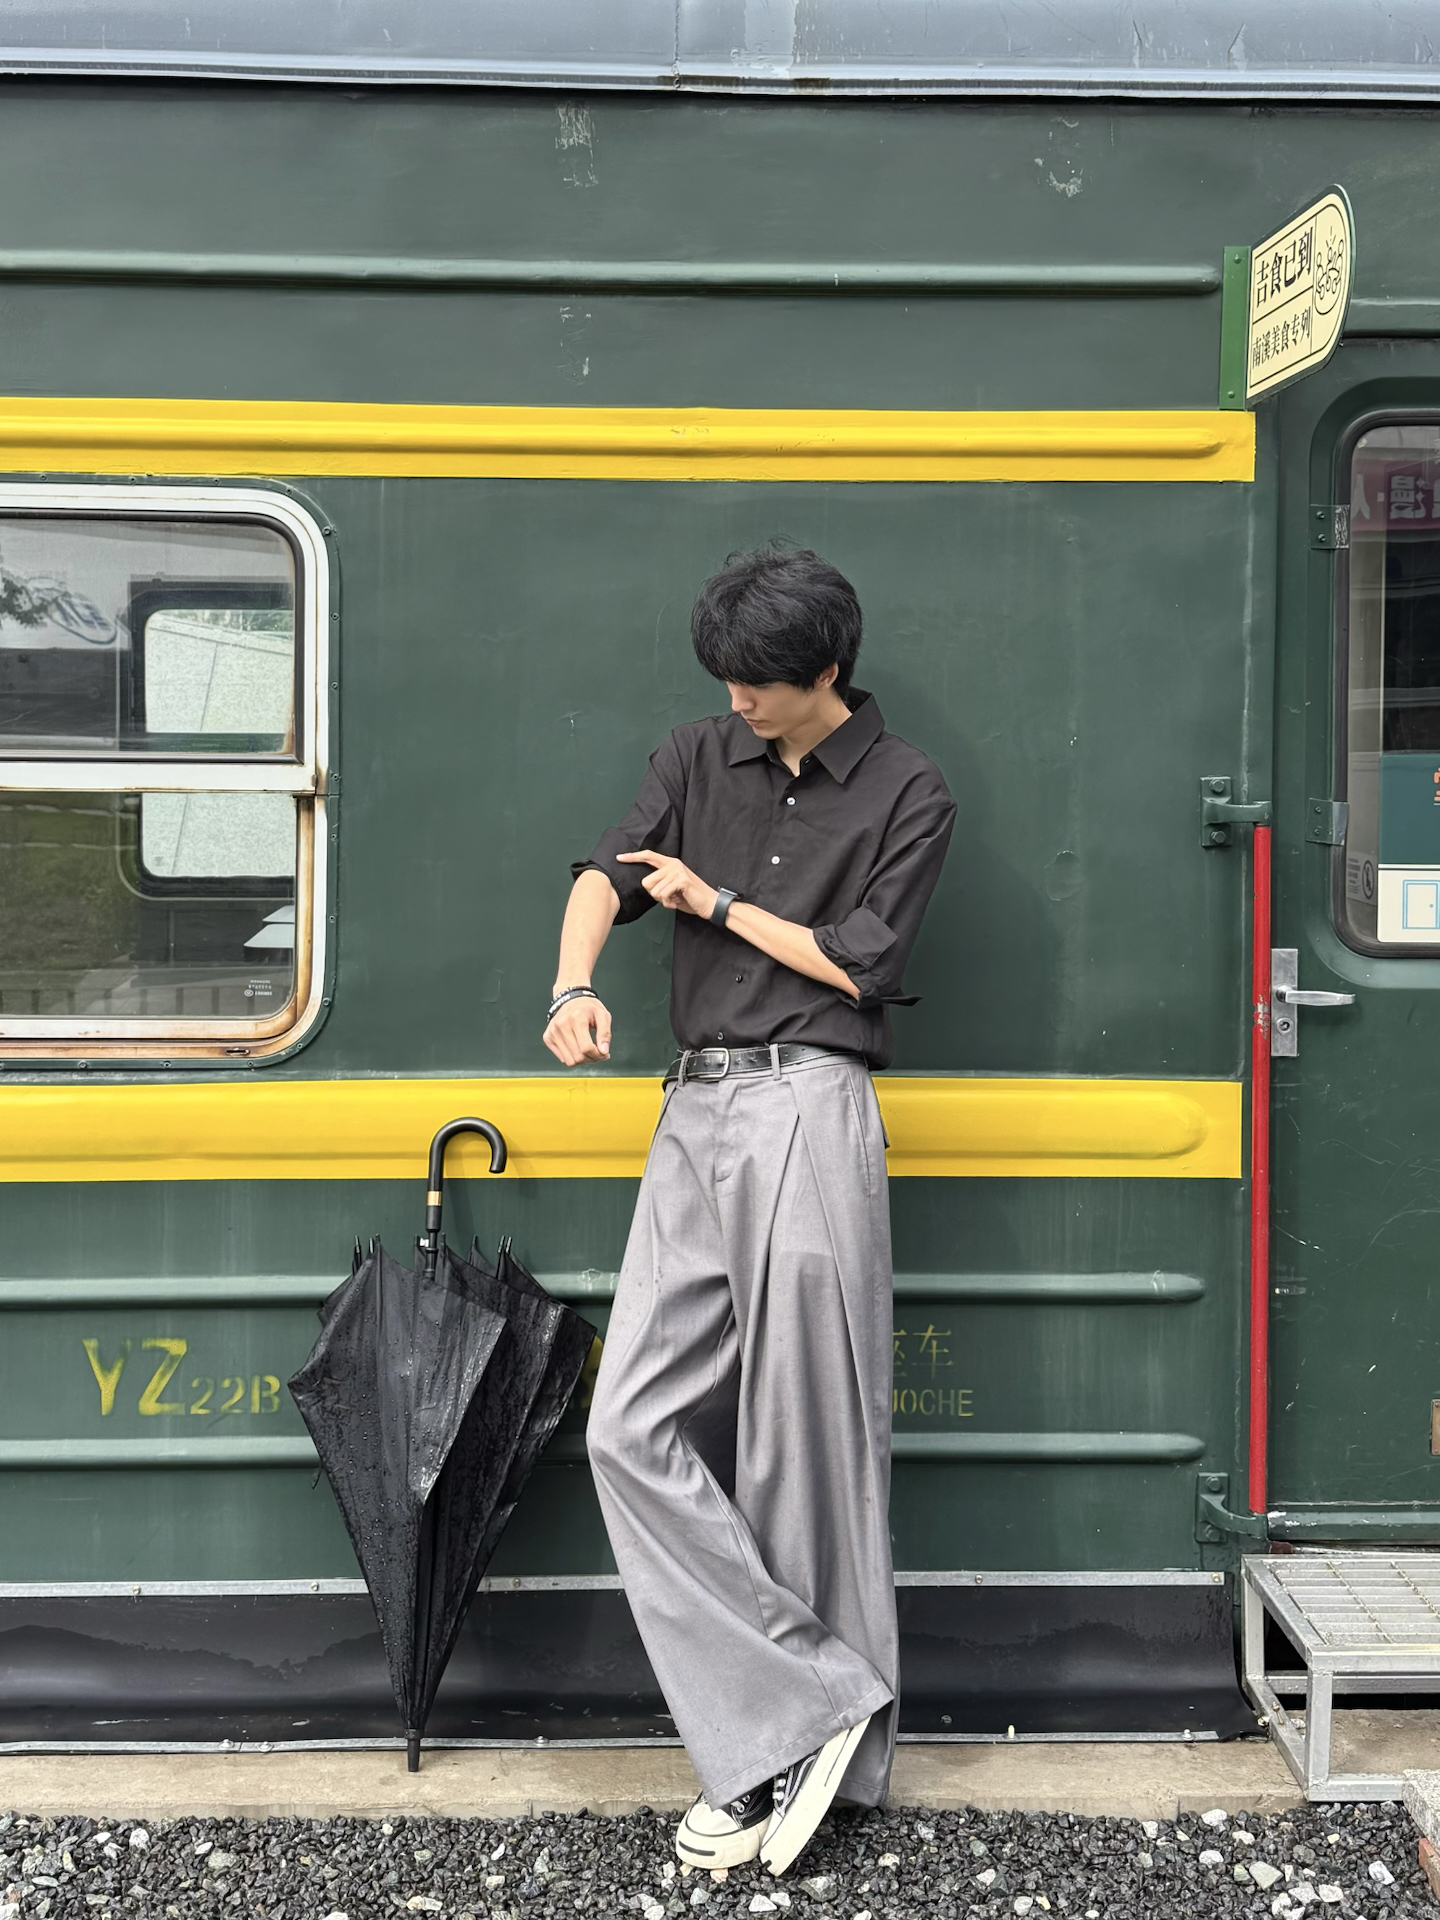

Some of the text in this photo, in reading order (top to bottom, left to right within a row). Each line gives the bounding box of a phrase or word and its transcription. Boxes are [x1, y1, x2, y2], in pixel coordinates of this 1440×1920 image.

[1256, 226, 1313, 308] 吉食已到
[1252, 306, 1311, 370] 南溪美食专列
